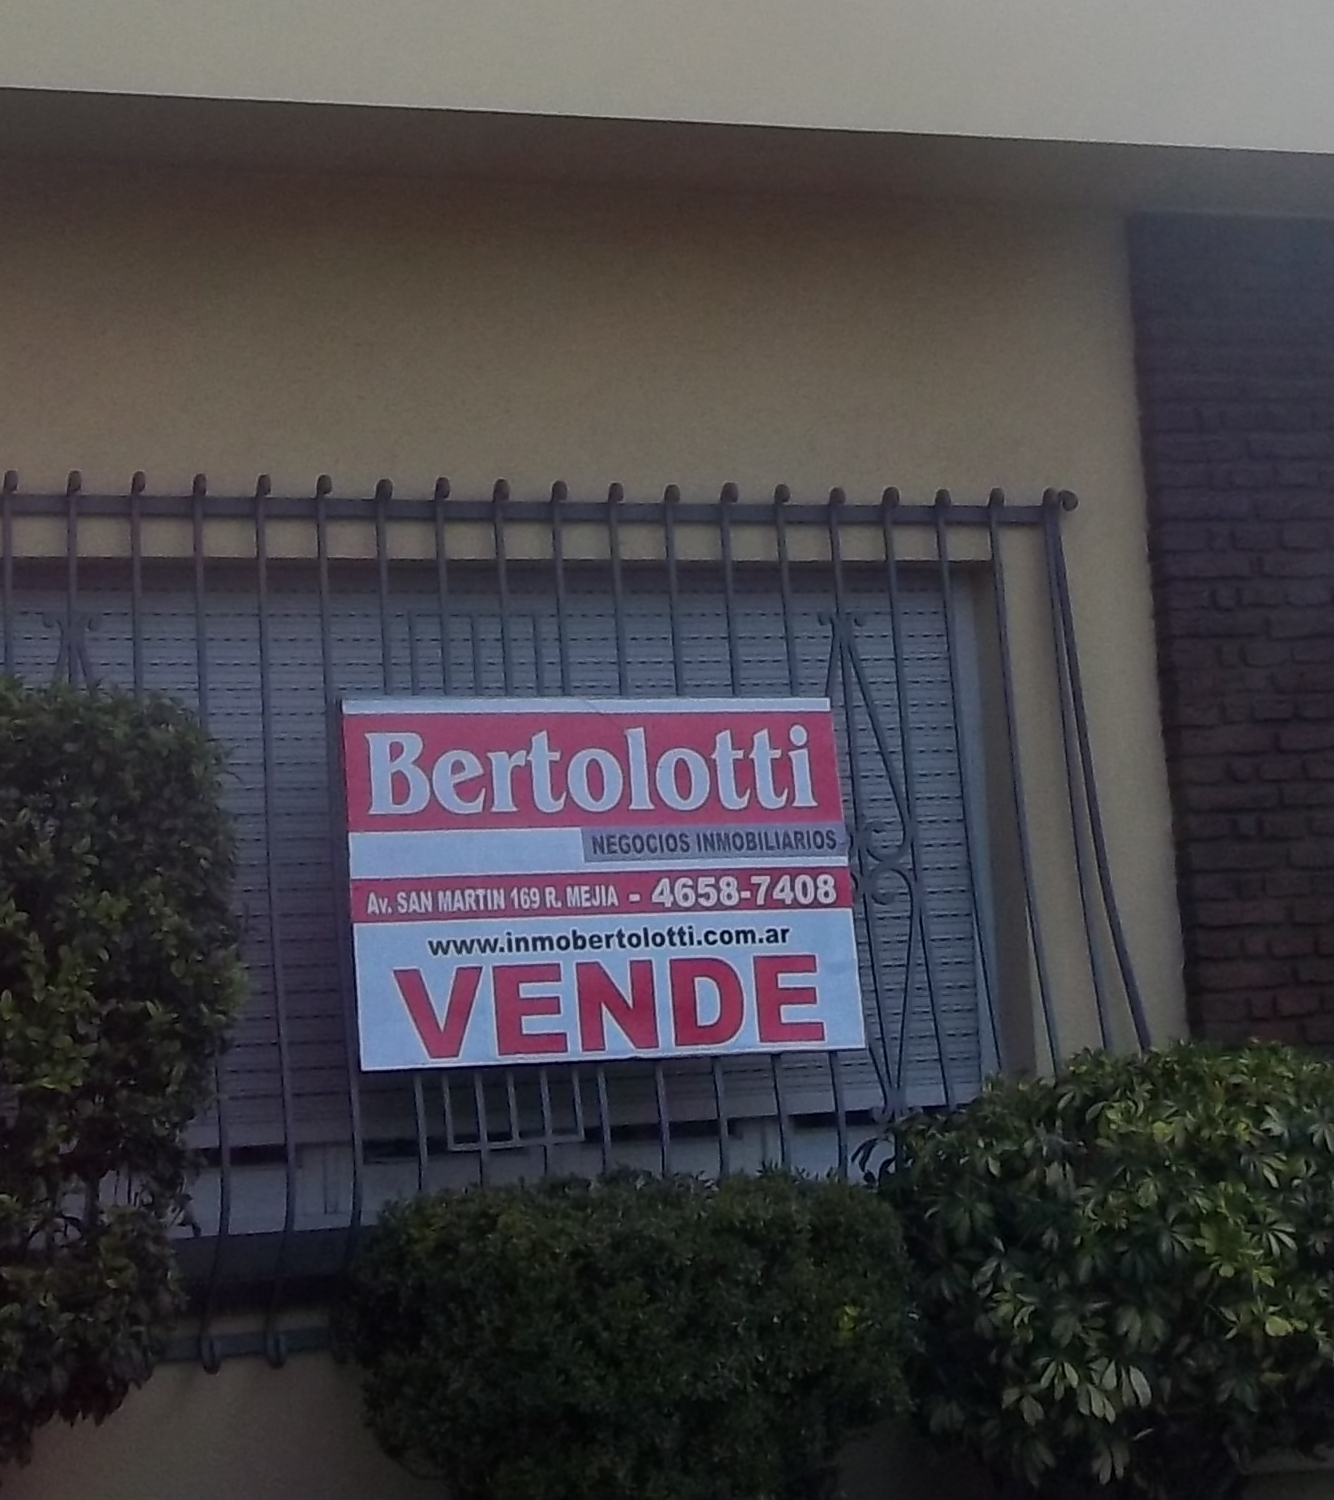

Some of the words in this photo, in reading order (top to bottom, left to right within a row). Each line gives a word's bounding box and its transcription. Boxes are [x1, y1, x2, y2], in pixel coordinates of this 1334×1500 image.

[364, 724, 818, 815] Bertolotti
[591, 833, 691, 855] NEGOCIOS
[696, 829, 838, 852] INMOBILIARIOS
[366, 891, 393, 915] Av.
[397, 890, 433, 913] SAN
[437, 887, 506, 912] MARTIN
[509, 886, 540, 909] 169
[544, 886, 562, 909] R.
[566, 884, 619, 908] MEJIA
[651, 873, 837, 908] 4658-7408
[427, 924, 791, 957] www.inmobertolotti.com.ar
[393, 953, 827, 1060] VENDE
